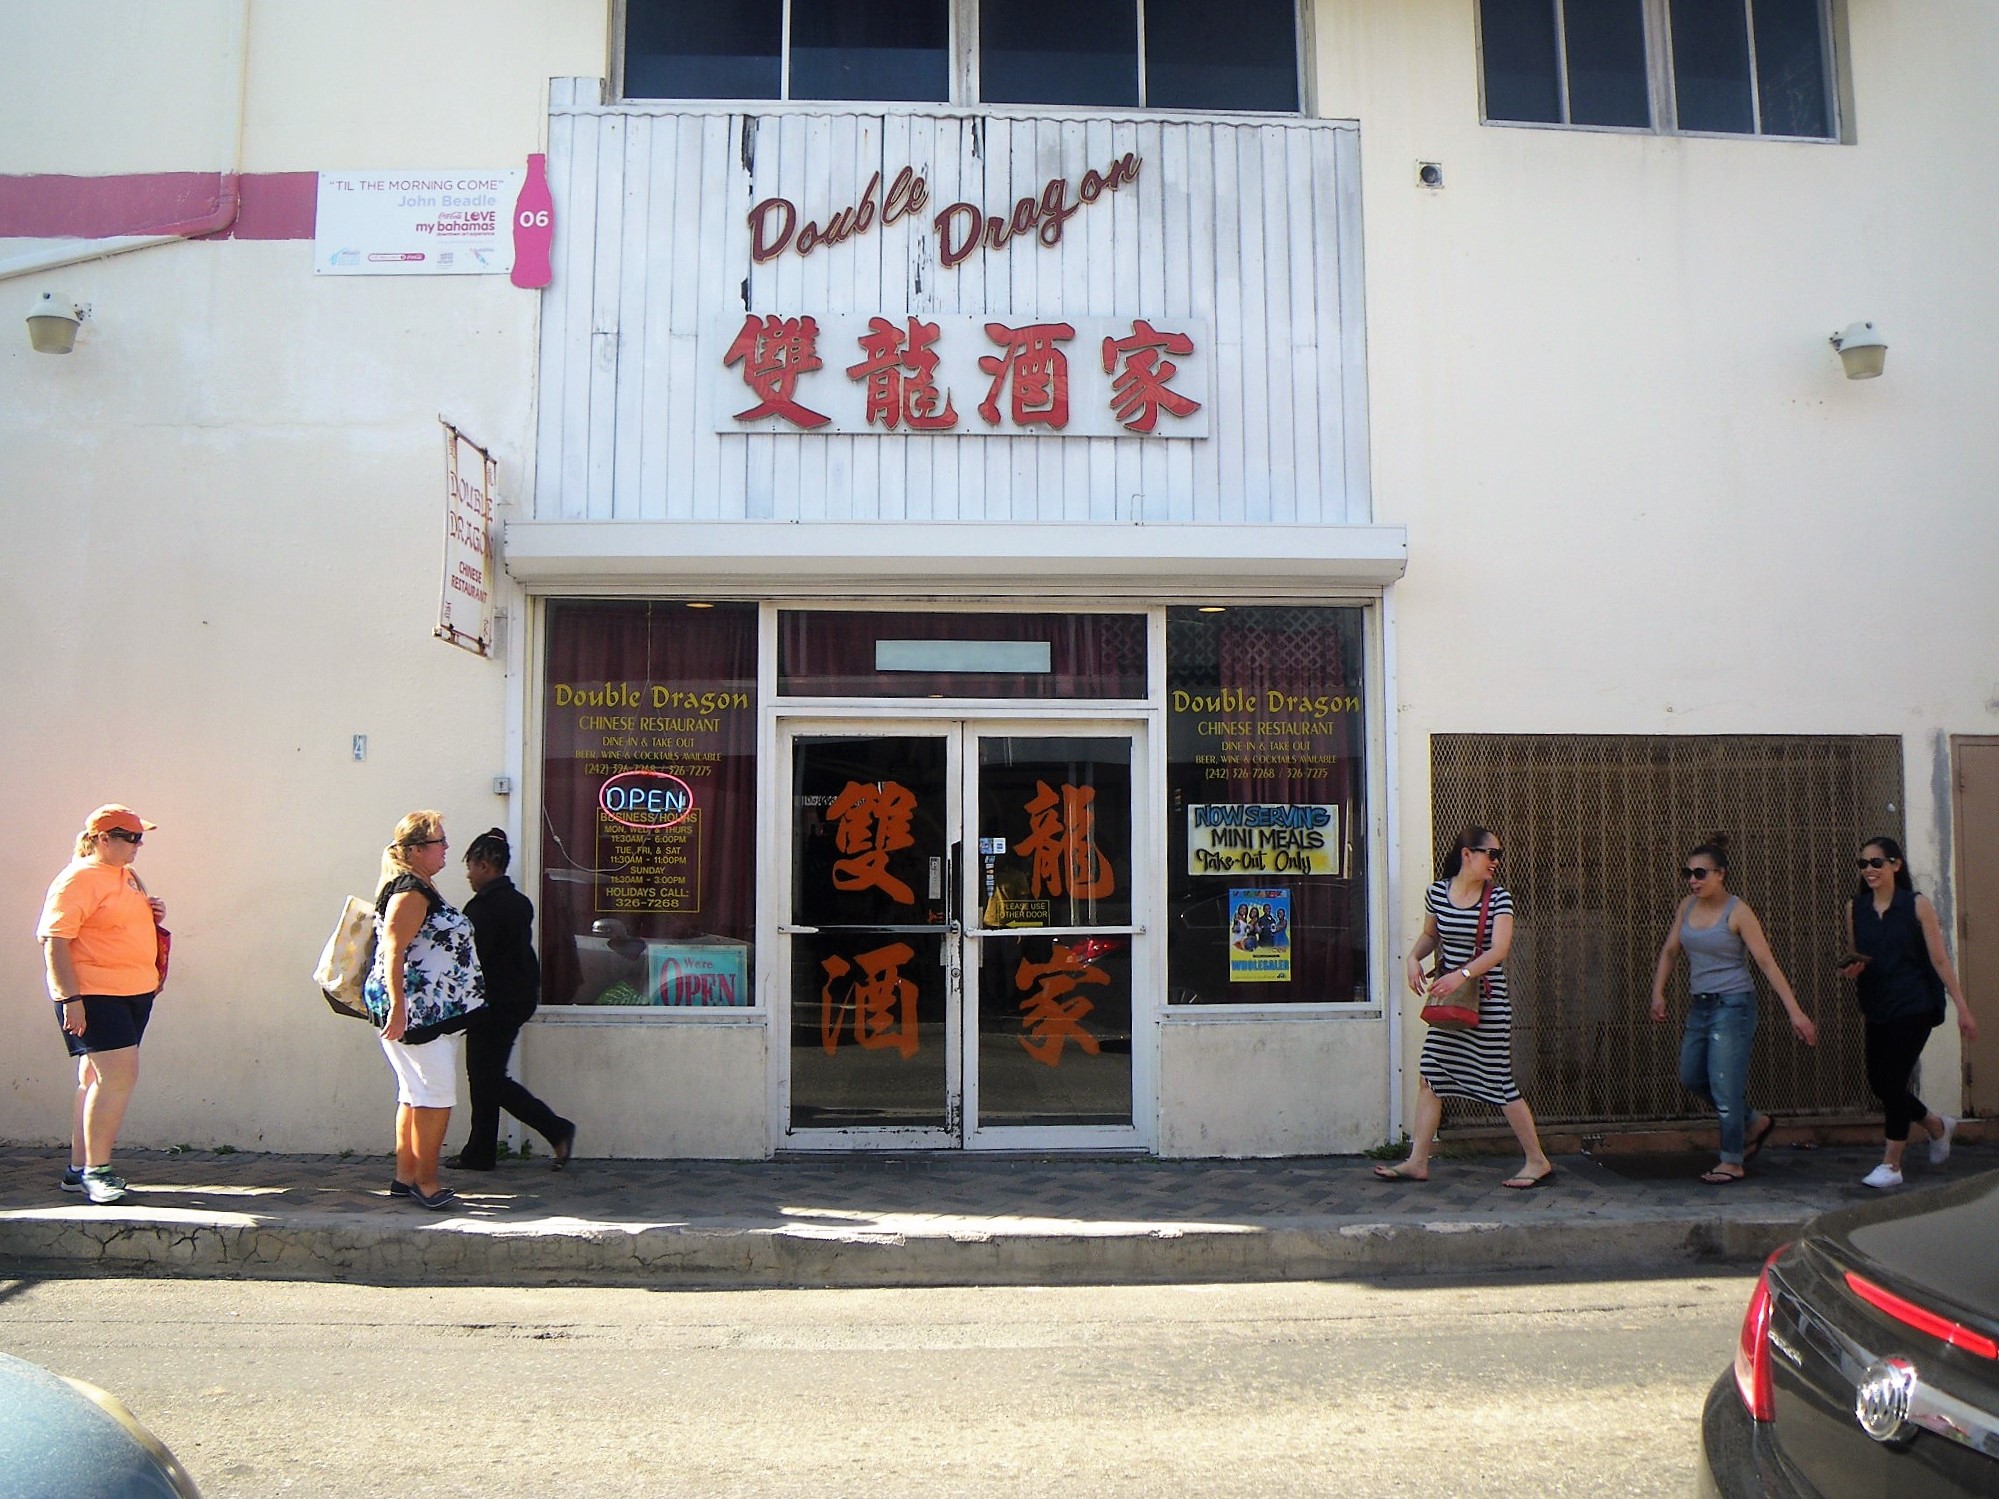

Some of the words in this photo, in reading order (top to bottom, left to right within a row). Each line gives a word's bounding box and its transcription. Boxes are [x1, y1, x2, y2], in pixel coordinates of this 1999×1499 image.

[360, 181, 384, 190] THE
[389, 180, 452, 190] MORNING
[398, 196, 436, 207] John
[442, 195, 496, 206] Beadle
[748, 166, 929, 264] Double
[935, 152, 1142, 268] Dragon
[520, 210, 548, 227] 06
[416, 223, 434, 234] my
[437, 221, 495, 231] bahamas
[450, 471, 493, 523] DOUBLE
[450, 511, 494, 560] DRAGON
[459, 561, 482, 583] CHINESE
[451, 575, 488, 604] RESTAURANT
[555, 682, 640, 708] Double
[652, 686, 748, 714] Dragon
[1172, 688, 1256, 713] Double
[1268, 690, 1360, 718] Dragon
[579, 716, 634, 731] CHINESE
[640, 718, 720, 732] RESTAURANT
[1198, 722, 1251, 736] CHINESE
[1258, 722, 1333, 735] RESTAURANT
[603, 737, 623, 746] DINE
[641, 738, 647, 747] &
[652, 737, 672, 747] TAKE
[676, 738, 694, 747] OUT
[1222, 741, 1241, 750] DINE
[1247, 741, 1255, 750] IN
[1270, 741, 1289, 750] TAKE
[1293, 741, 1310, 750] OUT
[600, 750, 621, 759] WINE
[624, 751, 630, 759] &
[634, 750, 679, 760] COCKTAILS
[680, 752, 722, 761] AVAILABLE
[1221, 755, 1239, 763] WINE
[1252, 755, 1297, 763] COCKTAILS
[1299, 756, 1336, 764] AVAILABLE
[585, 763, 608, 775] (242)
[1206, 768, 1229, 780] (242)
[606, 787, 685, 813] OPEN
[600, 813, 654, 822] BUSINESS
[1195, 804, 1243, 828] NOW
[1245, 804, 1331, 830] SERVING
[665, 826, 692, 834] THURS
[655, 835, 686, 843] 6:00PM
[1211, 828, 1252, 848] MINI
[1259, 829, 1325, 849] MEALS
[611, 856, 642, 864] 11:30AM
[1197, 849, 1267, 871] Take-Out
[1276, 850, 1311, 875] Only
[654, 876, 685, 884] 3:00PM
[606, 888, 656, 897] HOLIDAYS
[660, 888, 689, 897] CALL:
[616, 899, 679, 907] 326-7268
[660, 957, 736, 1006] OPEN
